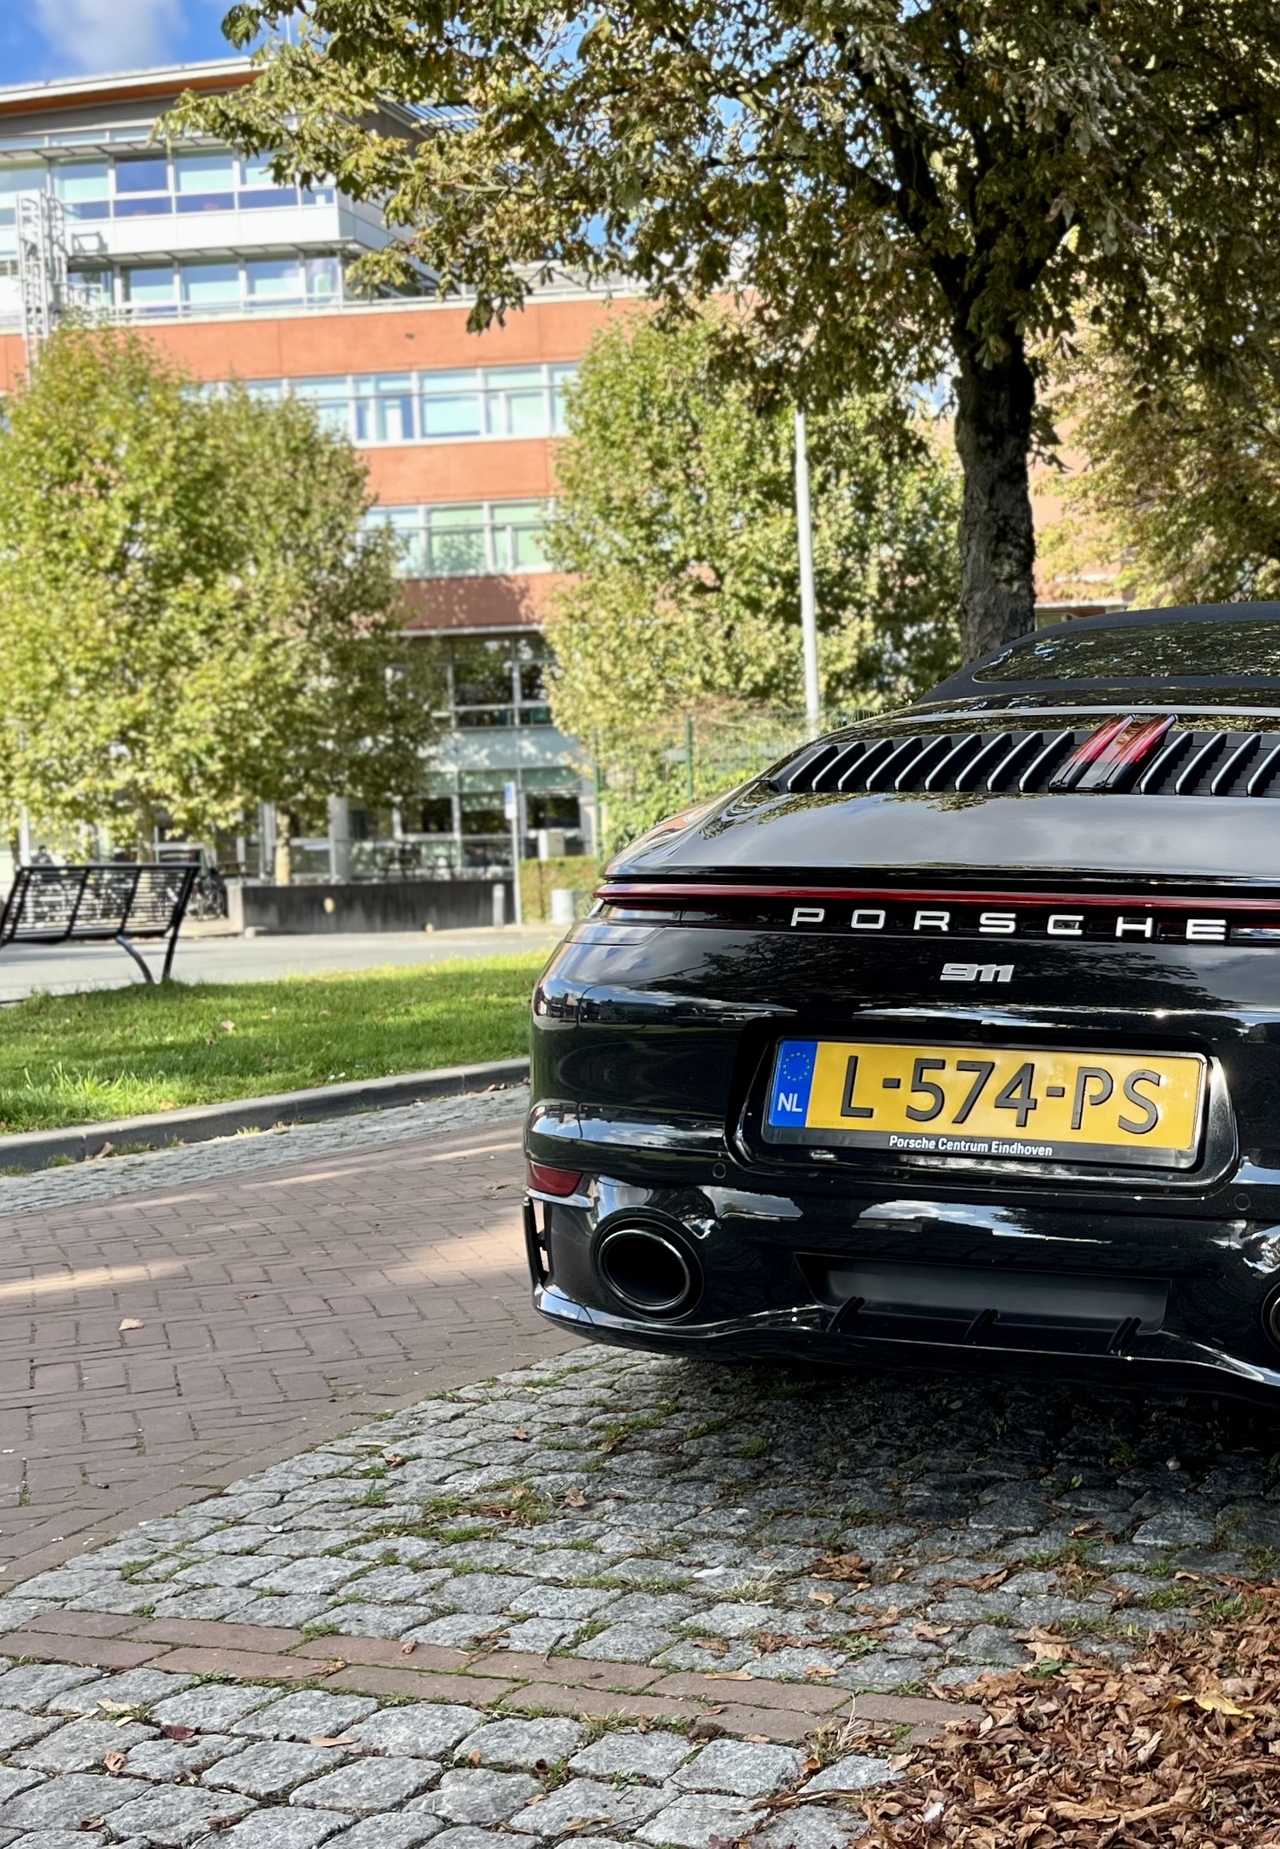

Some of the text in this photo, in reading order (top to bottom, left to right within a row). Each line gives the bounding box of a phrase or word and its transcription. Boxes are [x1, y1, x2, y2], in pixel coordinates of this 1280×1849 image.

[791, 908, 1226, 940] PORSCHE
[940, 963, 1014, 982] 911
[777, 1092, 803, 1112] NL
[840, 1055, 1161, 1134] L-574-PS
[889, 1135, 1053, 1156] Porsche Centrum Eindhoven
